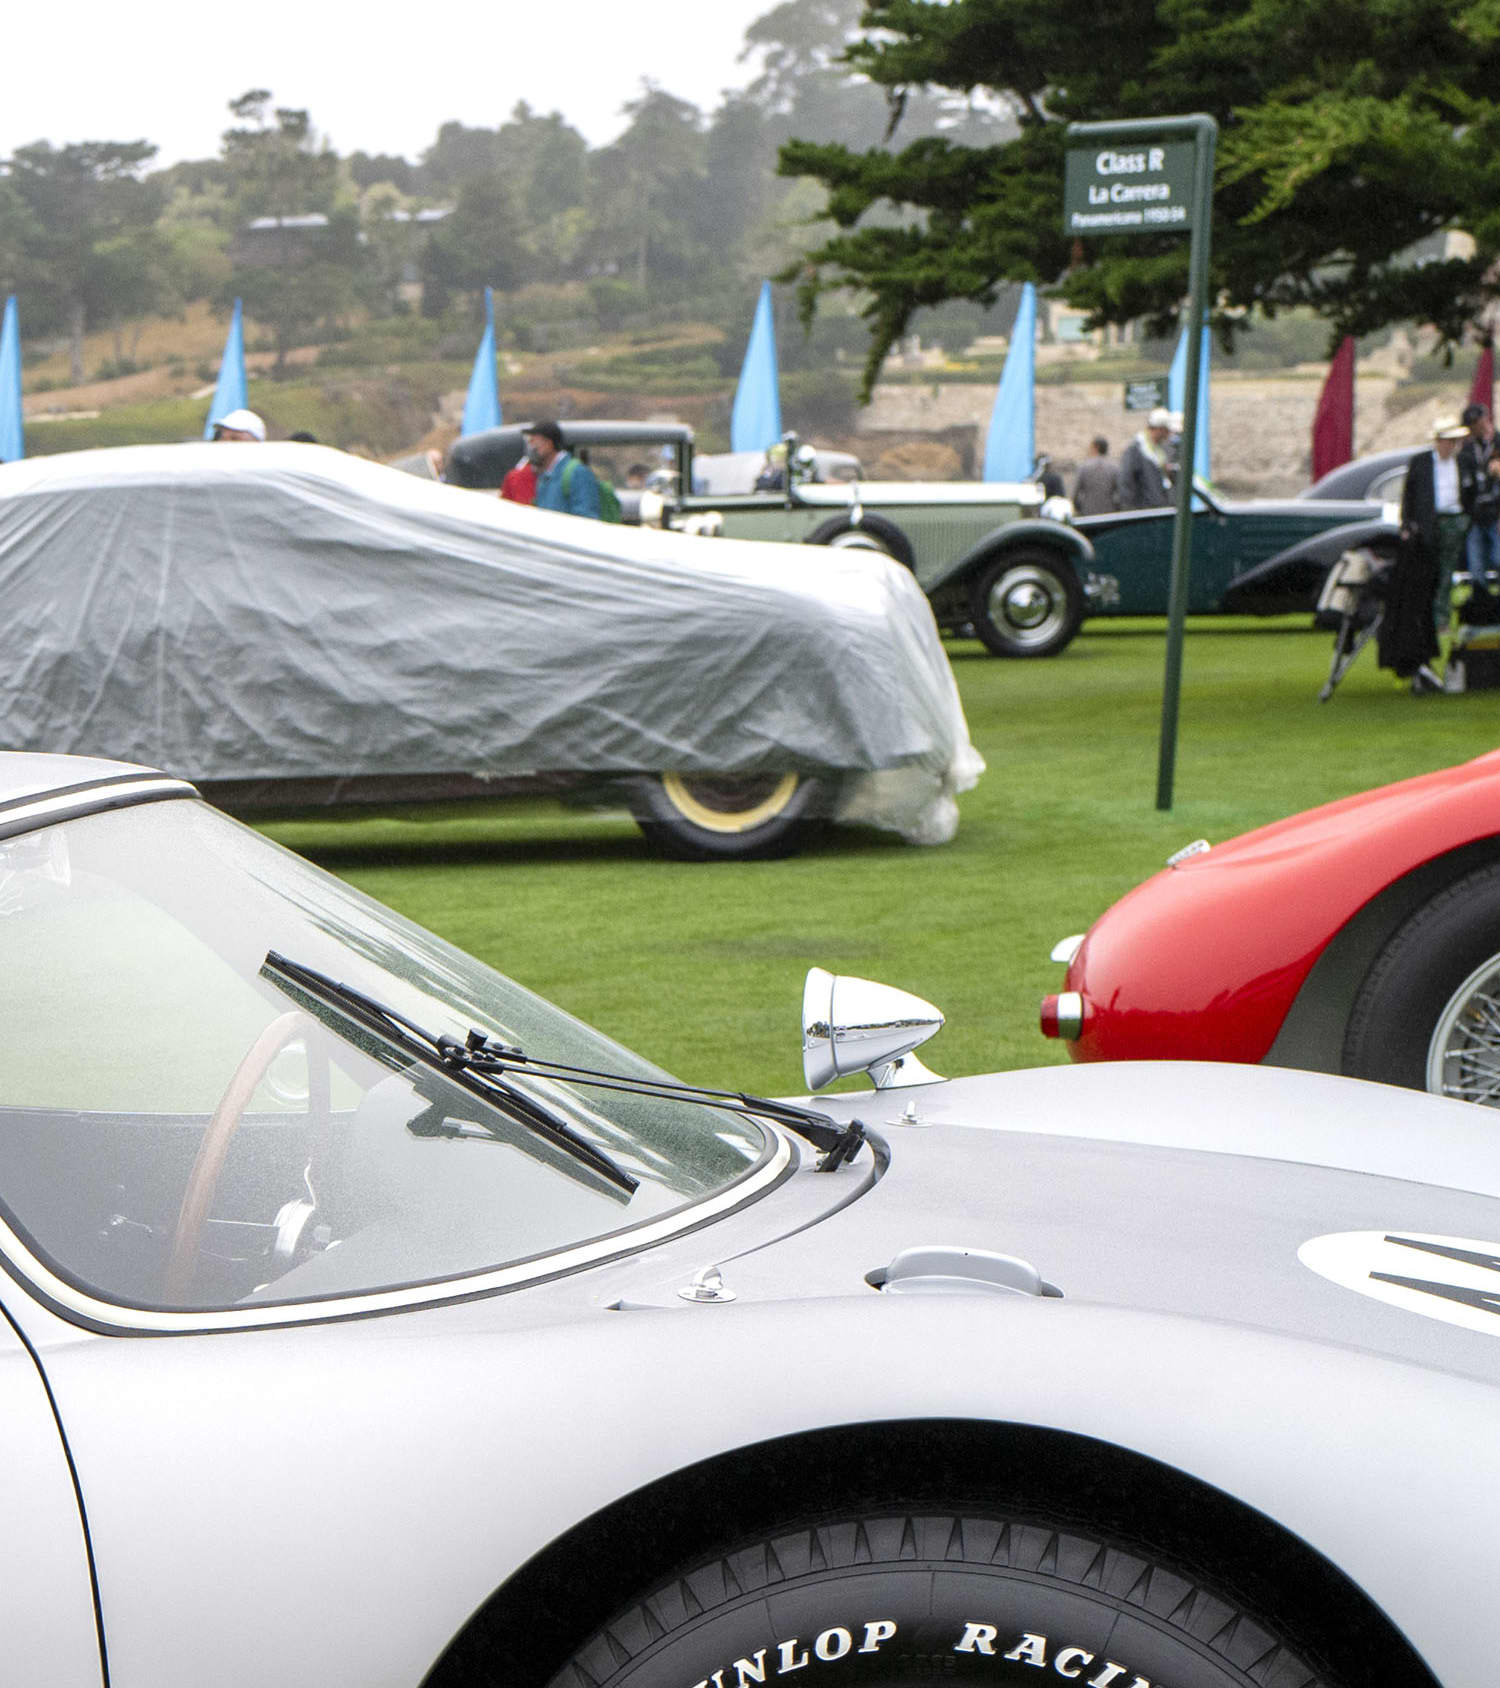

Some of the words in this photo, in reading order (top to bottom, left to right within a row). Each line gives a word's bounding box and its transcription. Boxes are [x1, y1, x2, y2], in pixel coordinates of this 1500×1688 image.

[1096, 151, 1146, 175] Class
[1148, 147, 1165, 171] R
[1088, 185, 1109, 205] La
[1110, 183, 1170, 203] Carrera
